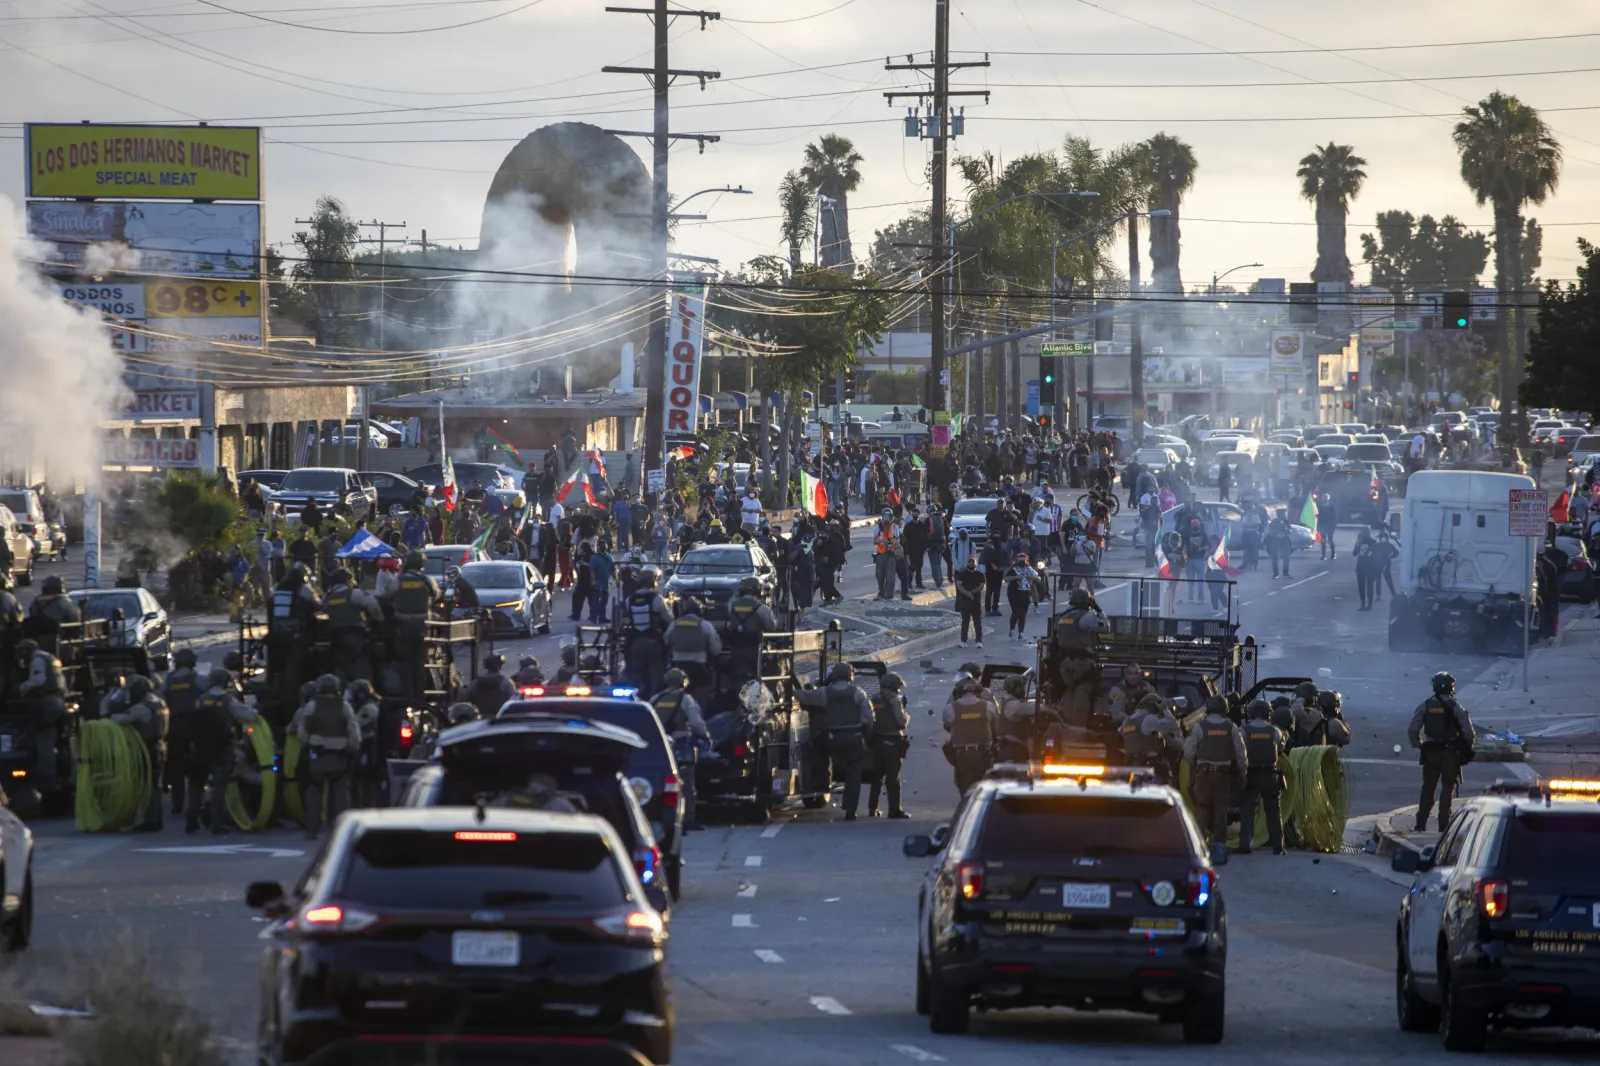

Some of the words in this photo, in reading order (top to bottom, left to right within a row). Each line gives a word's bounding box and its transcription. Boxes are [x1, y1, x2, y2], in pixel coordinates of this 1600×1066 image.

[37, 147, 65, 176] LOS
[69, 140, 98, 169] DOS
[104, 137, 185, 166] HERMANOS
[190, 141, 251, 178] MARKET
[95, 171, 156, 185] SPECIAL
[159, 172, 198, 186] MEAT
[42, 210, 105, 232] Sinaloa
[1043, 343, 1073, 352] Atlantic
[1074, 342, 1093, 351] Blvd
[668, 296, 695, 431] LIQUOR
[1511, 491, 1520, 501] NO
[1520, 491, 1546, 501] PARKING
[1510, 503, 1531, 512] ENTIRE
[1532, 503, 1546, 512] CITY
[1007, 911, 1040, 920] ANGELES
[1043, 912, 1073, 921] COUNTY
[1005, 923, 1056, 933] SHERIFF
[1515, 929, 1529, 938] LOS
[1533, 930, 1569, 939] ANGELES
[1532, 942, 1586, 954] SHERIFF
